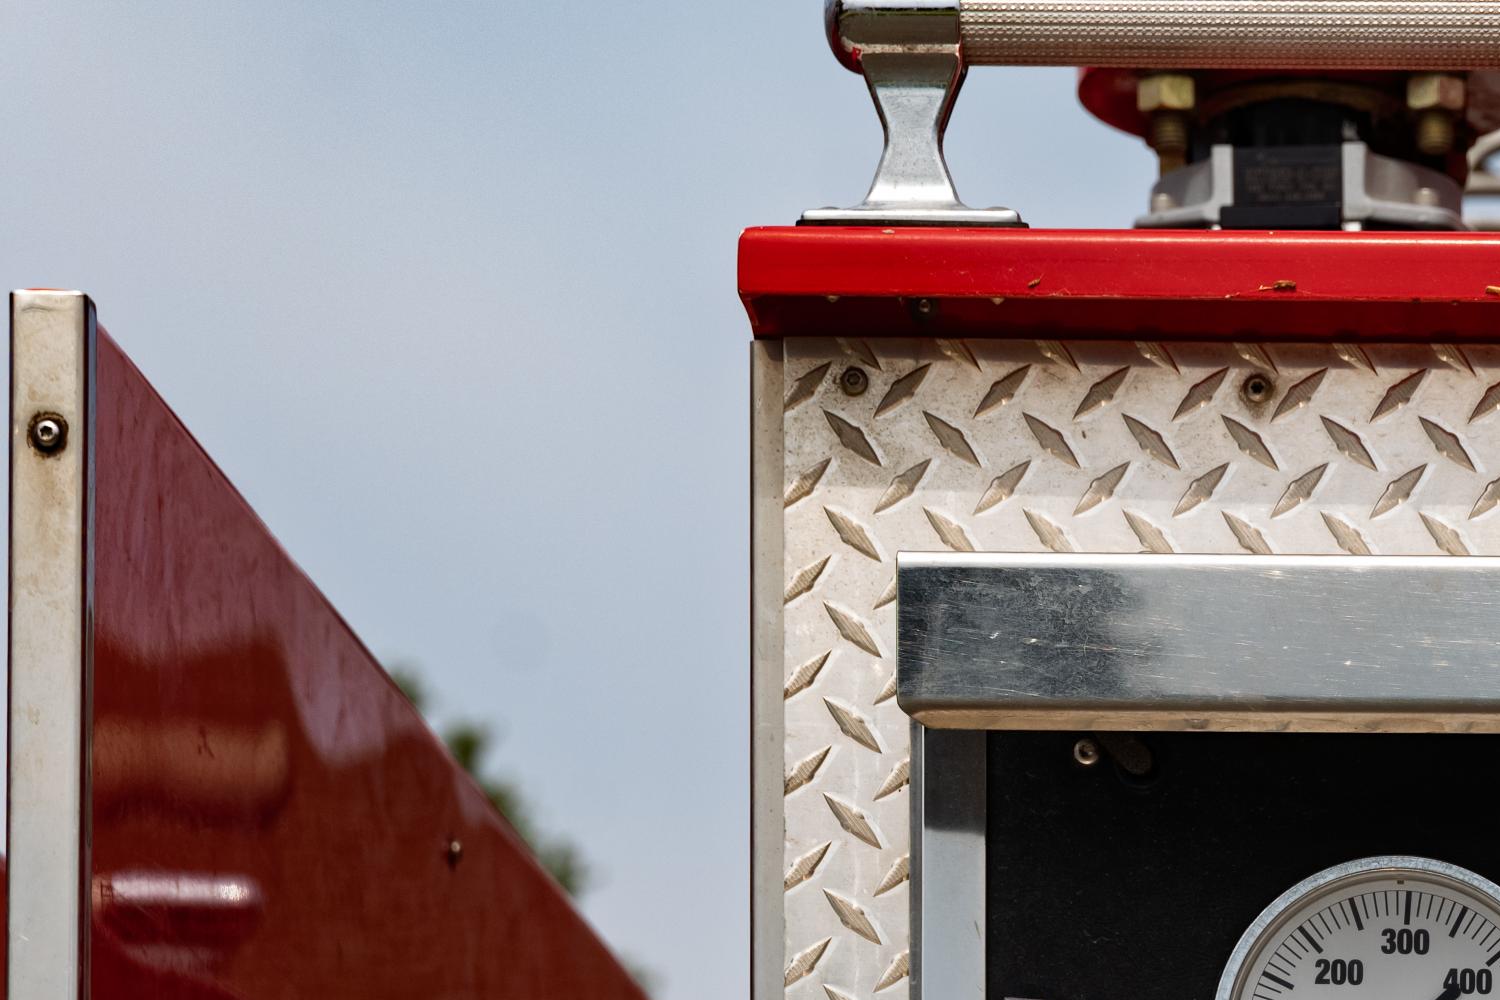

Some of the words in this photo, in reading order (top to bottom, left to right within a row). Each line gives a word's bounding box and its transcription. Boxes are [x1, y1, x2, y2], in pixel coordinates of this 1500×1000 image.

[1381, 928, 1430, 955] 300
[1315, 959, 1364, 985] 200
[1443, 968, 1492, 995] 400
